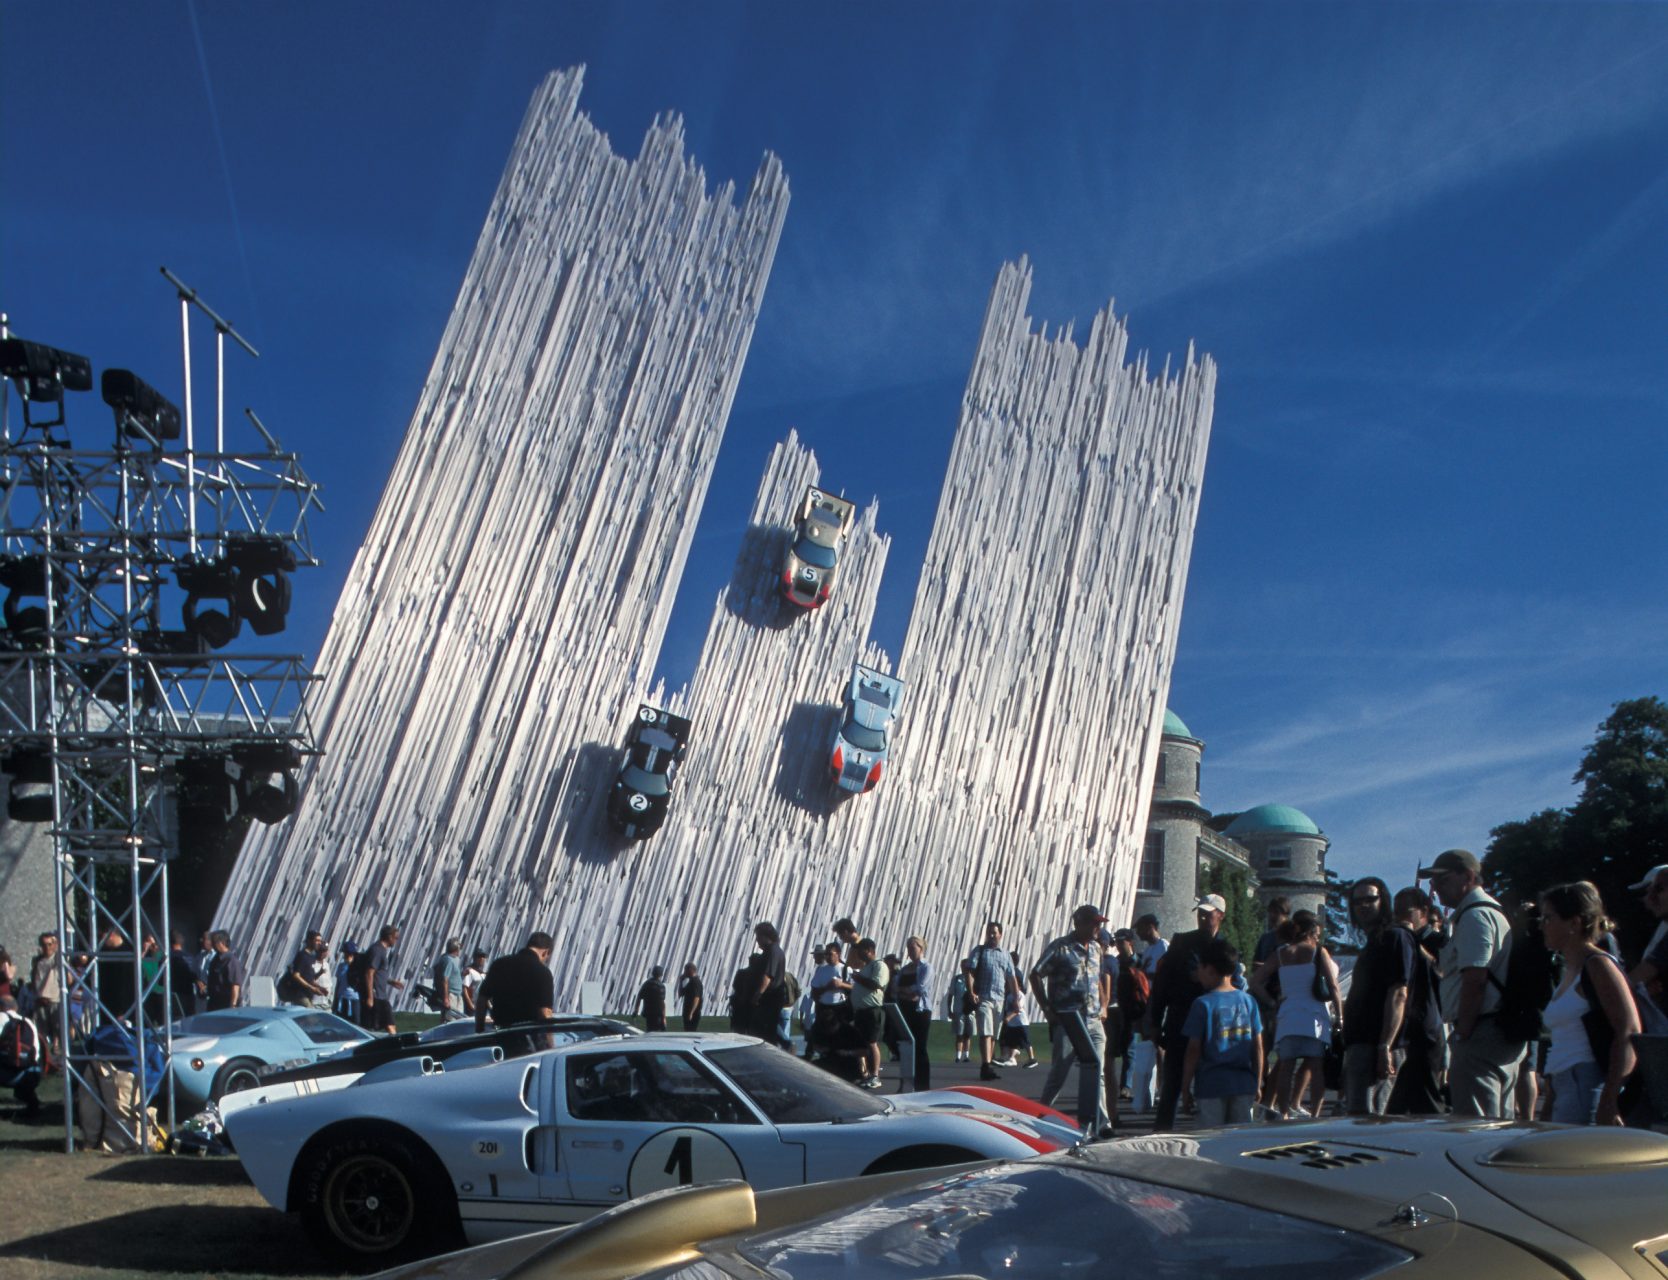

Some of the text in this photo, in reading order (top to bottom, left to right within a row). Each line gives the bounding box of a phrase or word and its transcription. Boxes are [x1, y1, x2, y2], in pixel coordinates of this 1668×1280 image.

[806, 569, 814, 580] 5
[856, 752, 862, 764] 1
[633, 796, 644, 809] 2
[479, 1141, 498, 1154] 201
[663, 1136, 693, 1185] 1
